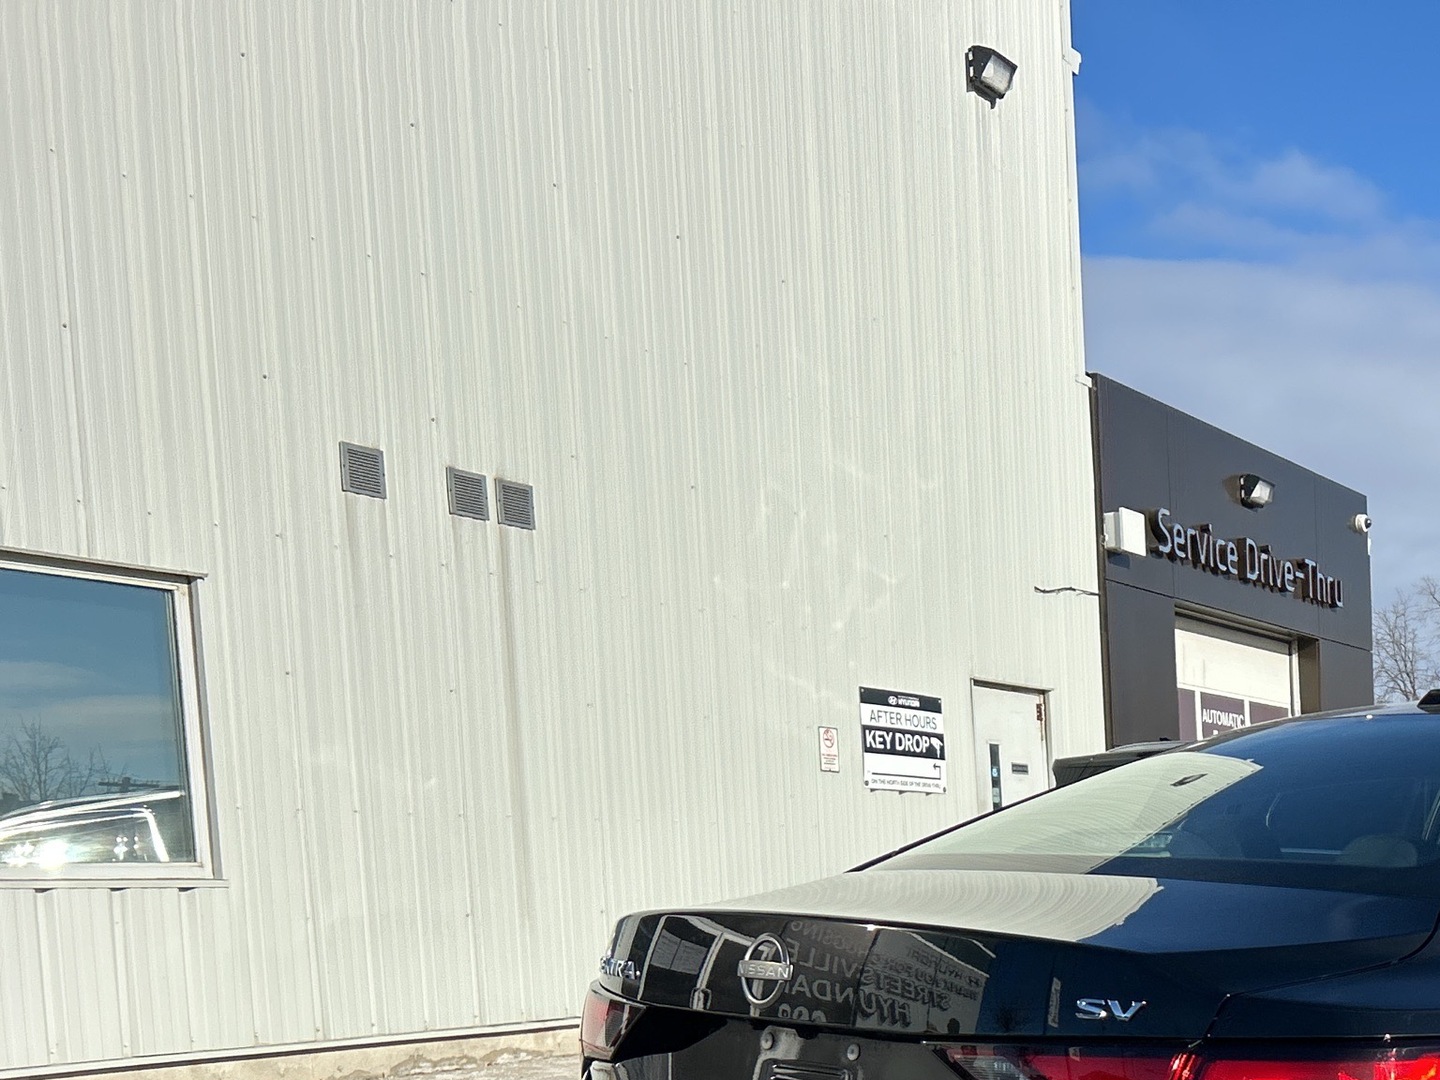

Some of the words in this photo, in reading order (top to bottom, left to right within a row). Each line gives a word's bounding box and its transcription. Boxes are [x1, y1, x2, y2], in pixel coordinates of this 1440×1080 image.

[1156, 507, 1238, 575] Service
[1245, 537, 1344, 608] Drive-Thru
[869, 709, 902, 725] AFTER
[904, 714, 938, 730] HOURS
[1202, 708, 1245, 729] AUTOMATIC
[865, 729, 893, 750] KEY
[895, 732, 931, 753] DROP
[737, 962, 789, 979] NISSAN
[1075, 998, 1147, 1021] SV
